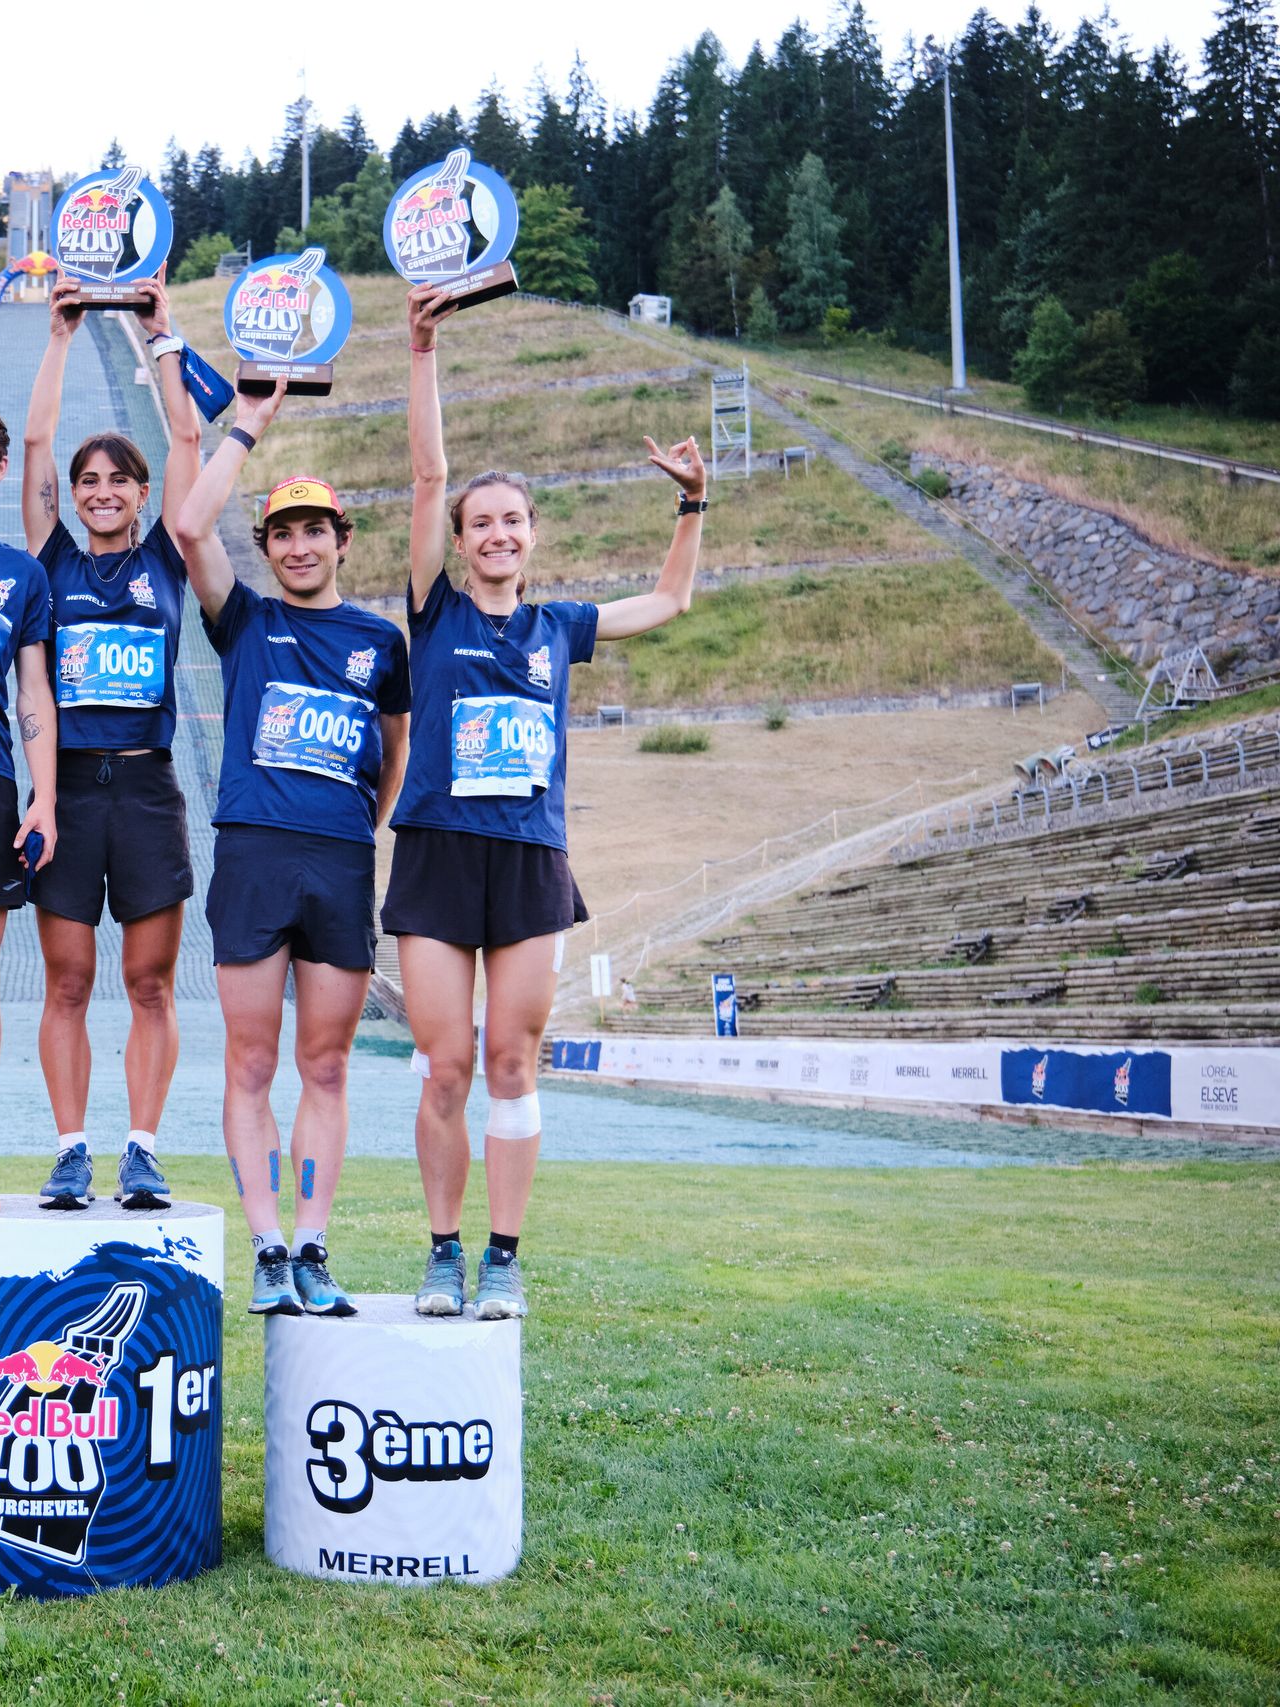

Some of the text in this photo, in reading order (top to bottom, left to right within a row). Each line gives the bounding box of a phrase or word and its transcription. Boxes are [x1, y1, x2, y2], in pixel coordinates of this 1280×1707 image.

[62, 214, 127, 229] Red Bull
[395, 200, 467, 239] Red Bull
[60, 230, 119, 252] 400
[400, 223, 464, 258] 400
[64, 254, 114, 262] COURCHEVEL
[408, 248, 462, 270] COURCHEVEL
[239, 291, 308, 309] Red Bull
[236, 309, 298, 331] 400
[240, 332, 293, 340] COURCHEVEL
[66, 595, 108, 607] MERRELL
[61, 663, 84, 674] 400
[96, 643, 154, 677] 1005
[262, 723, 289, 735] 400
[299, 708, 365, 752] 0005
[497, 717, 548, 755] 1003
[456, 739, 485, 750] 400
[300, 755, 326, 765] MERRELL
[896, 1066, 930, 1078] MERRELL
[952, 1066, 988, 1080] MERRELL
[1201, 1086, 1238, 1103] ELSEVE
[1215, 1104, 1238, 1112] BOOSTER
[46, 1397, 118, 1440] Bull
[139, 1356, 216, 1465] 1er
[310, 1404, 491, 1499] 3ème
[319, 1548, 479, 1578] MERRELL
